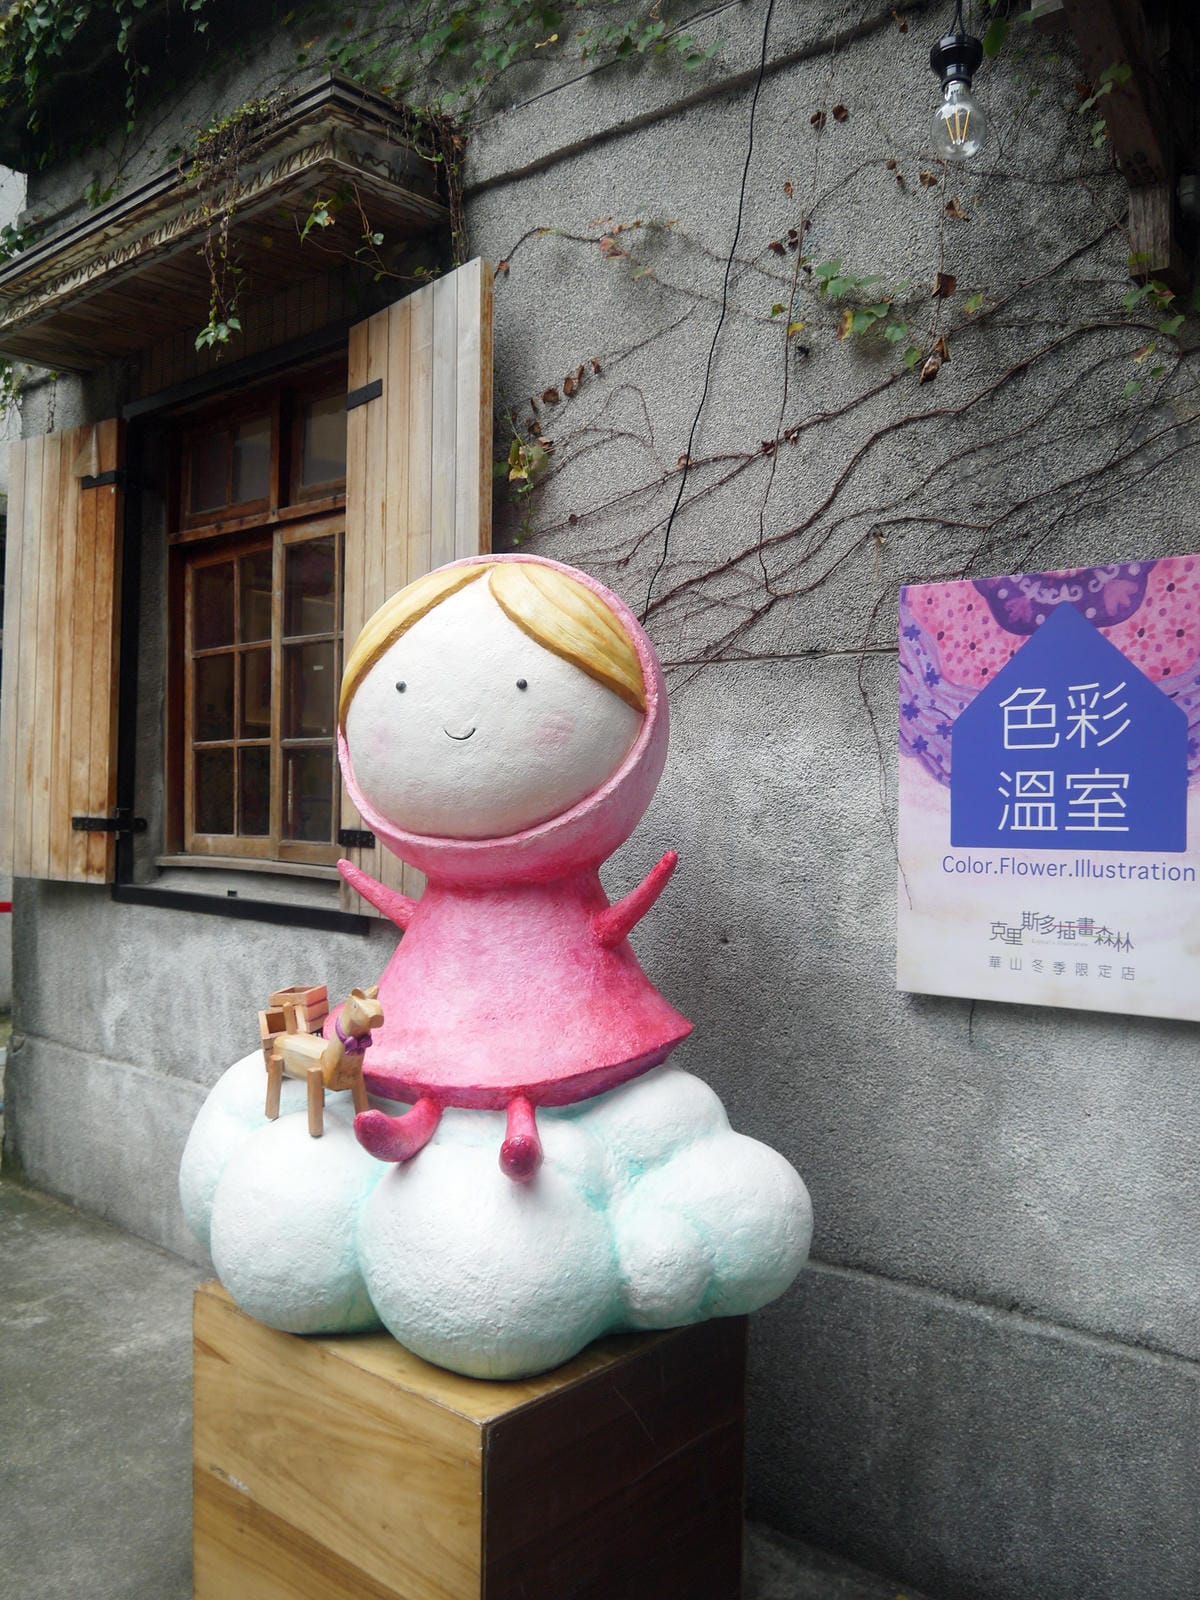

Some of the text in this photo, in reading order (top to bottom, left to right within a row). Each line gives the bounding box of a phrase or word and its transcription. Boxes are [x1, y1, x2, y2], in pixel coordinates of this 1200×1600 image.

[998, 681, 1131, 750] 色彩
[998, 767, 1130, 832] 溫室
[942, 855, 1196, 882] Color.Flower.Illustration
[988, 955, 1136, 981] 華山冬季限定店
